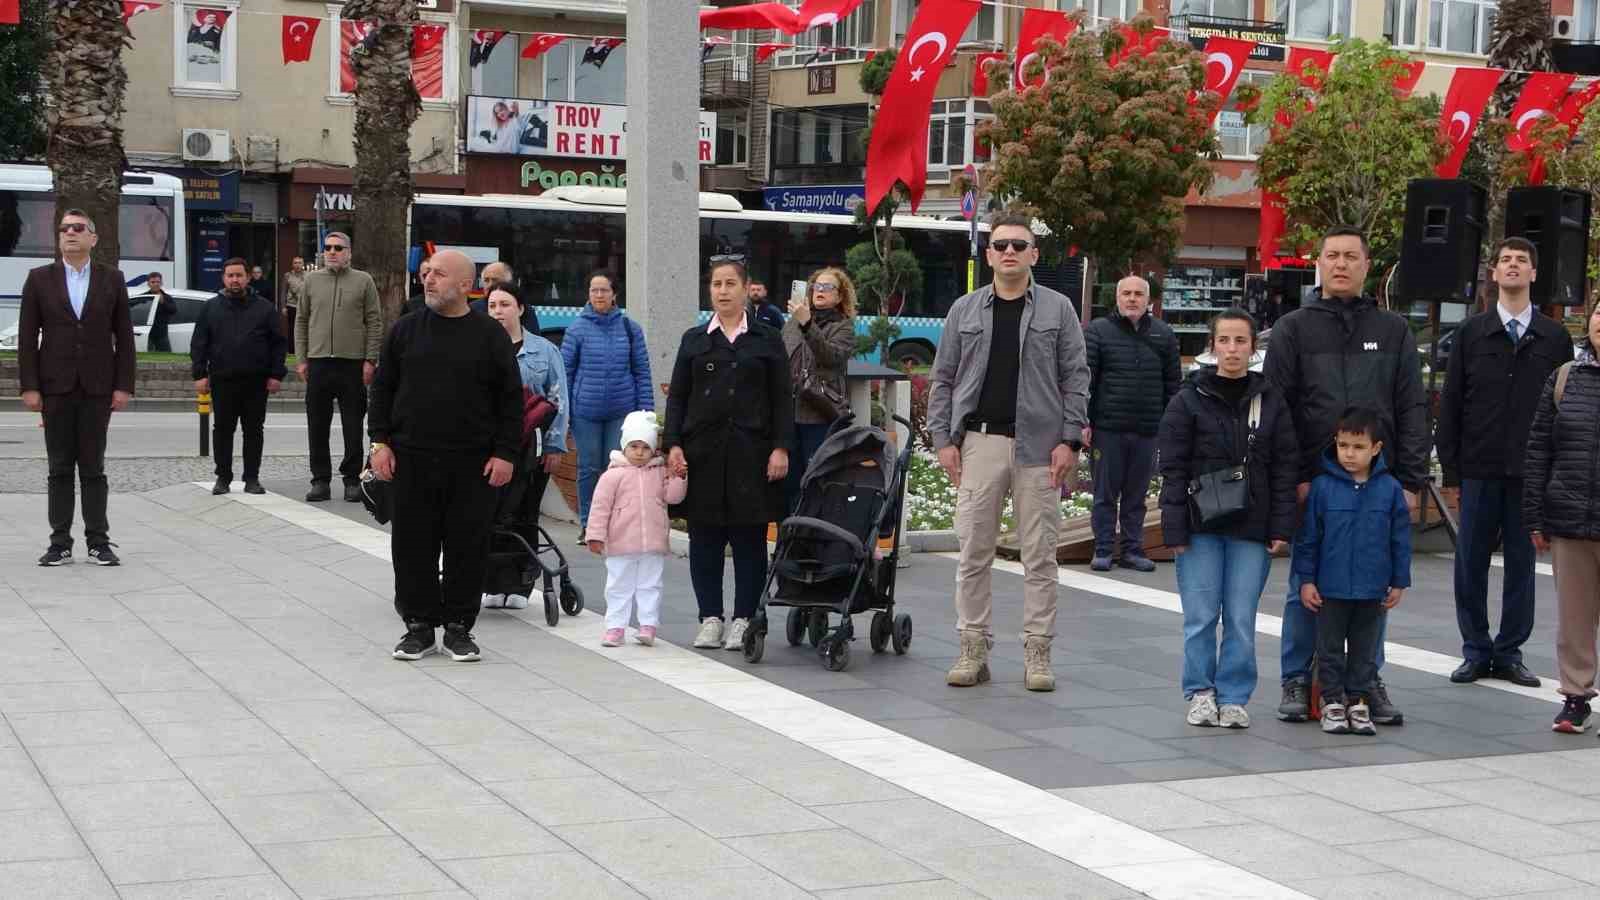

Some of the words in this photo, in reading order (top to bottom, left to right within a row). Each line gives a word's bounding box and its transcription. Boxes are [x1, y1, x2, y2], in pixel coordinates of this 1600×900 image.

[555, 104, 601, 129] TROY
[556, 132, 620, 156] RENT
[313, 192, 355, 210] AYN
[782, 190, 844, 210] Samanyolu
